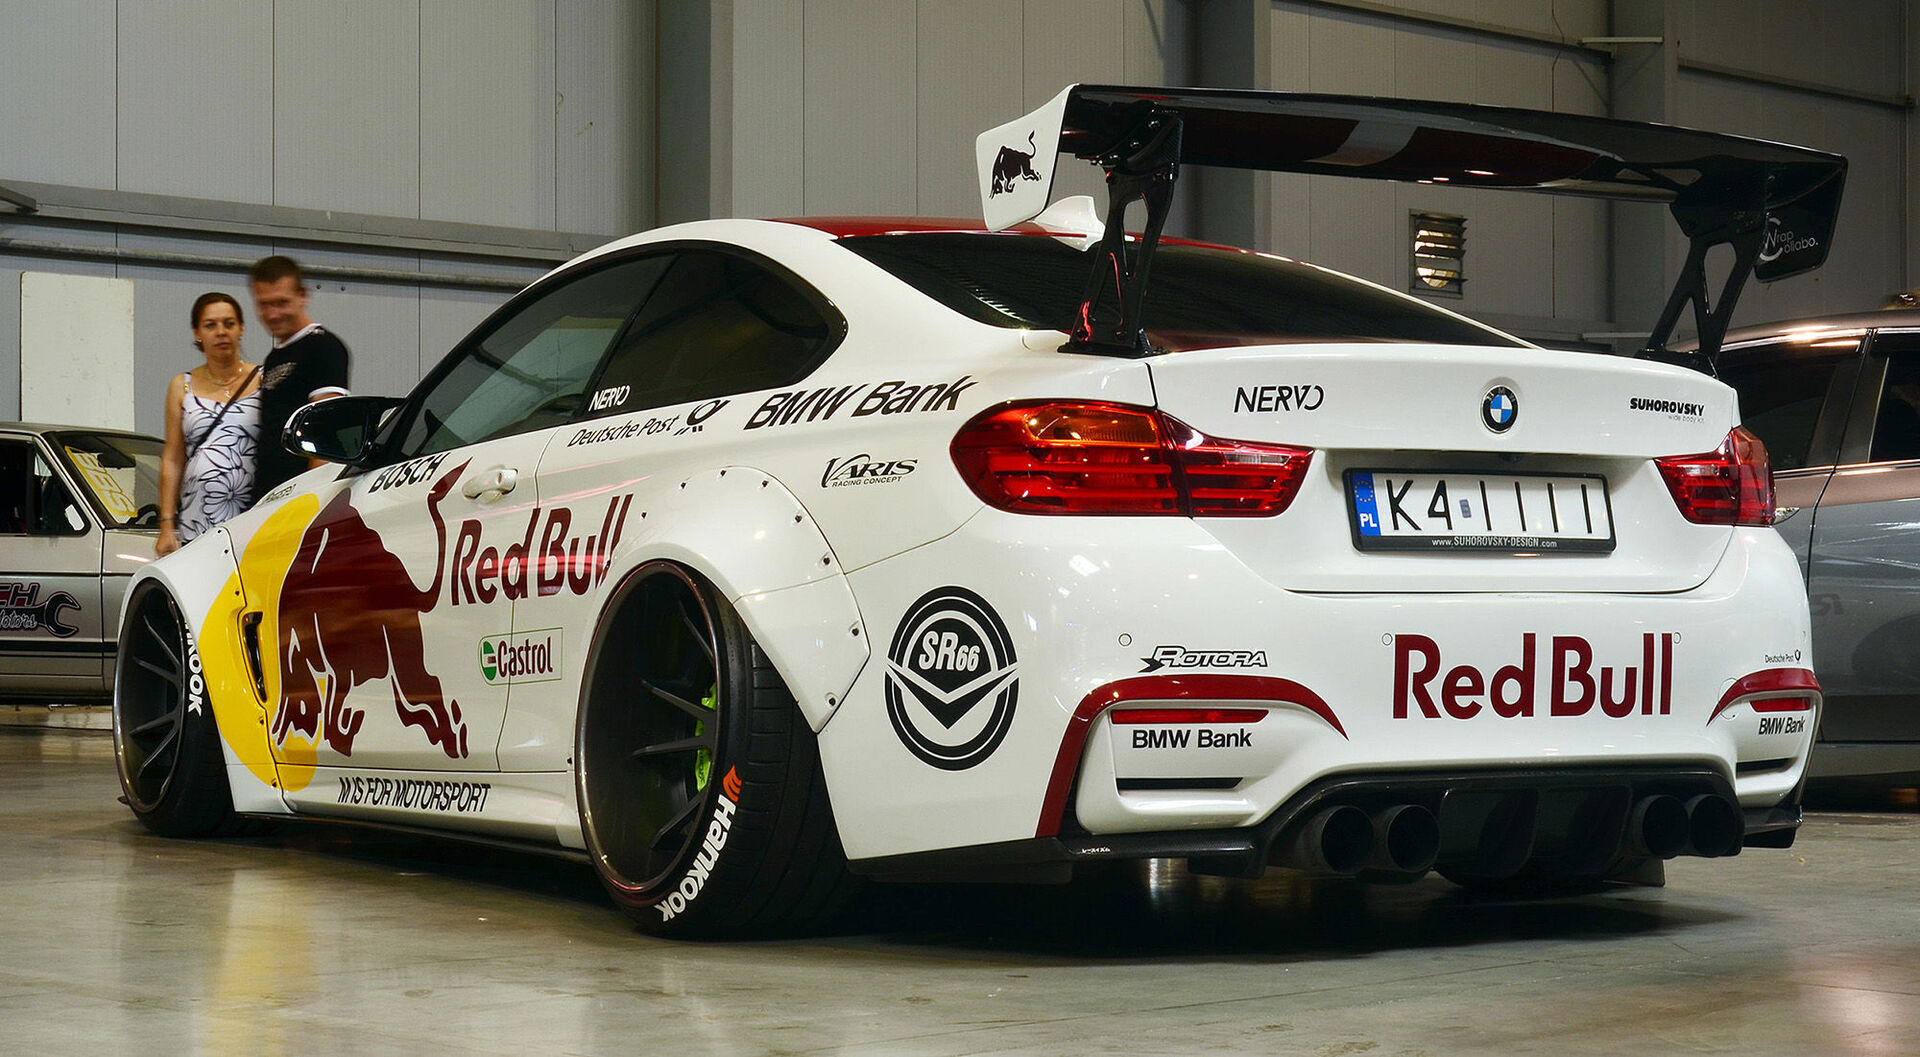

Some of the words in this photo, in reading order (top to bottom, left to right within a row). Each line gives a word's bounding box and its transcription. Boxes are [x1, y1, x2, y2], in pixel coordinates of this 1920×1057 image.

[588, 384, 631, 412] NERVO
[743, 383, 869, 430] BMW
[851, 375, 979, 417] Bank
[1234, 384, 1325, 413] NERVO
[1630, 397, 1705, 416] SUHOROVSKY
[567, 420, 638, 447] Deutsche
[637, 415, 680, 437] Post
[368, 452, 451, 494] BOSCH
[821, 453, 918, 488] VARIS
[832, 479, 862, 487] RACING
[863, 475, 903, 485] CONCEPT
[1359, 513, 1378, 528] PL
[1386, 479, 1453, 531] K4
[451, 507, 541, 606] Red
[537, 494, 633, 597] Bull
[497, 636, 553, 677] Castrol
[919, 630, 980, 672] SR66
[1152, 645, 1268, 668] ROTORA
[1392, 632, 1536, 719] Red
[1550, 632, 1673, 718] Bull
[1132, 729, 1191, 748] BMW
[1197, 728, 1253, 748] Bank
[1758, 717, 1785, 735] BMW
[1784, 716, 1805, 734] Bank
[337, 776, 351, 804] M
[350, 776, 365, 805] IS
[364, 777, 393, 806] FOR
[391, 778, 492, 812] MOTORSPORT
[654, 793, 736, 922] Hankook
